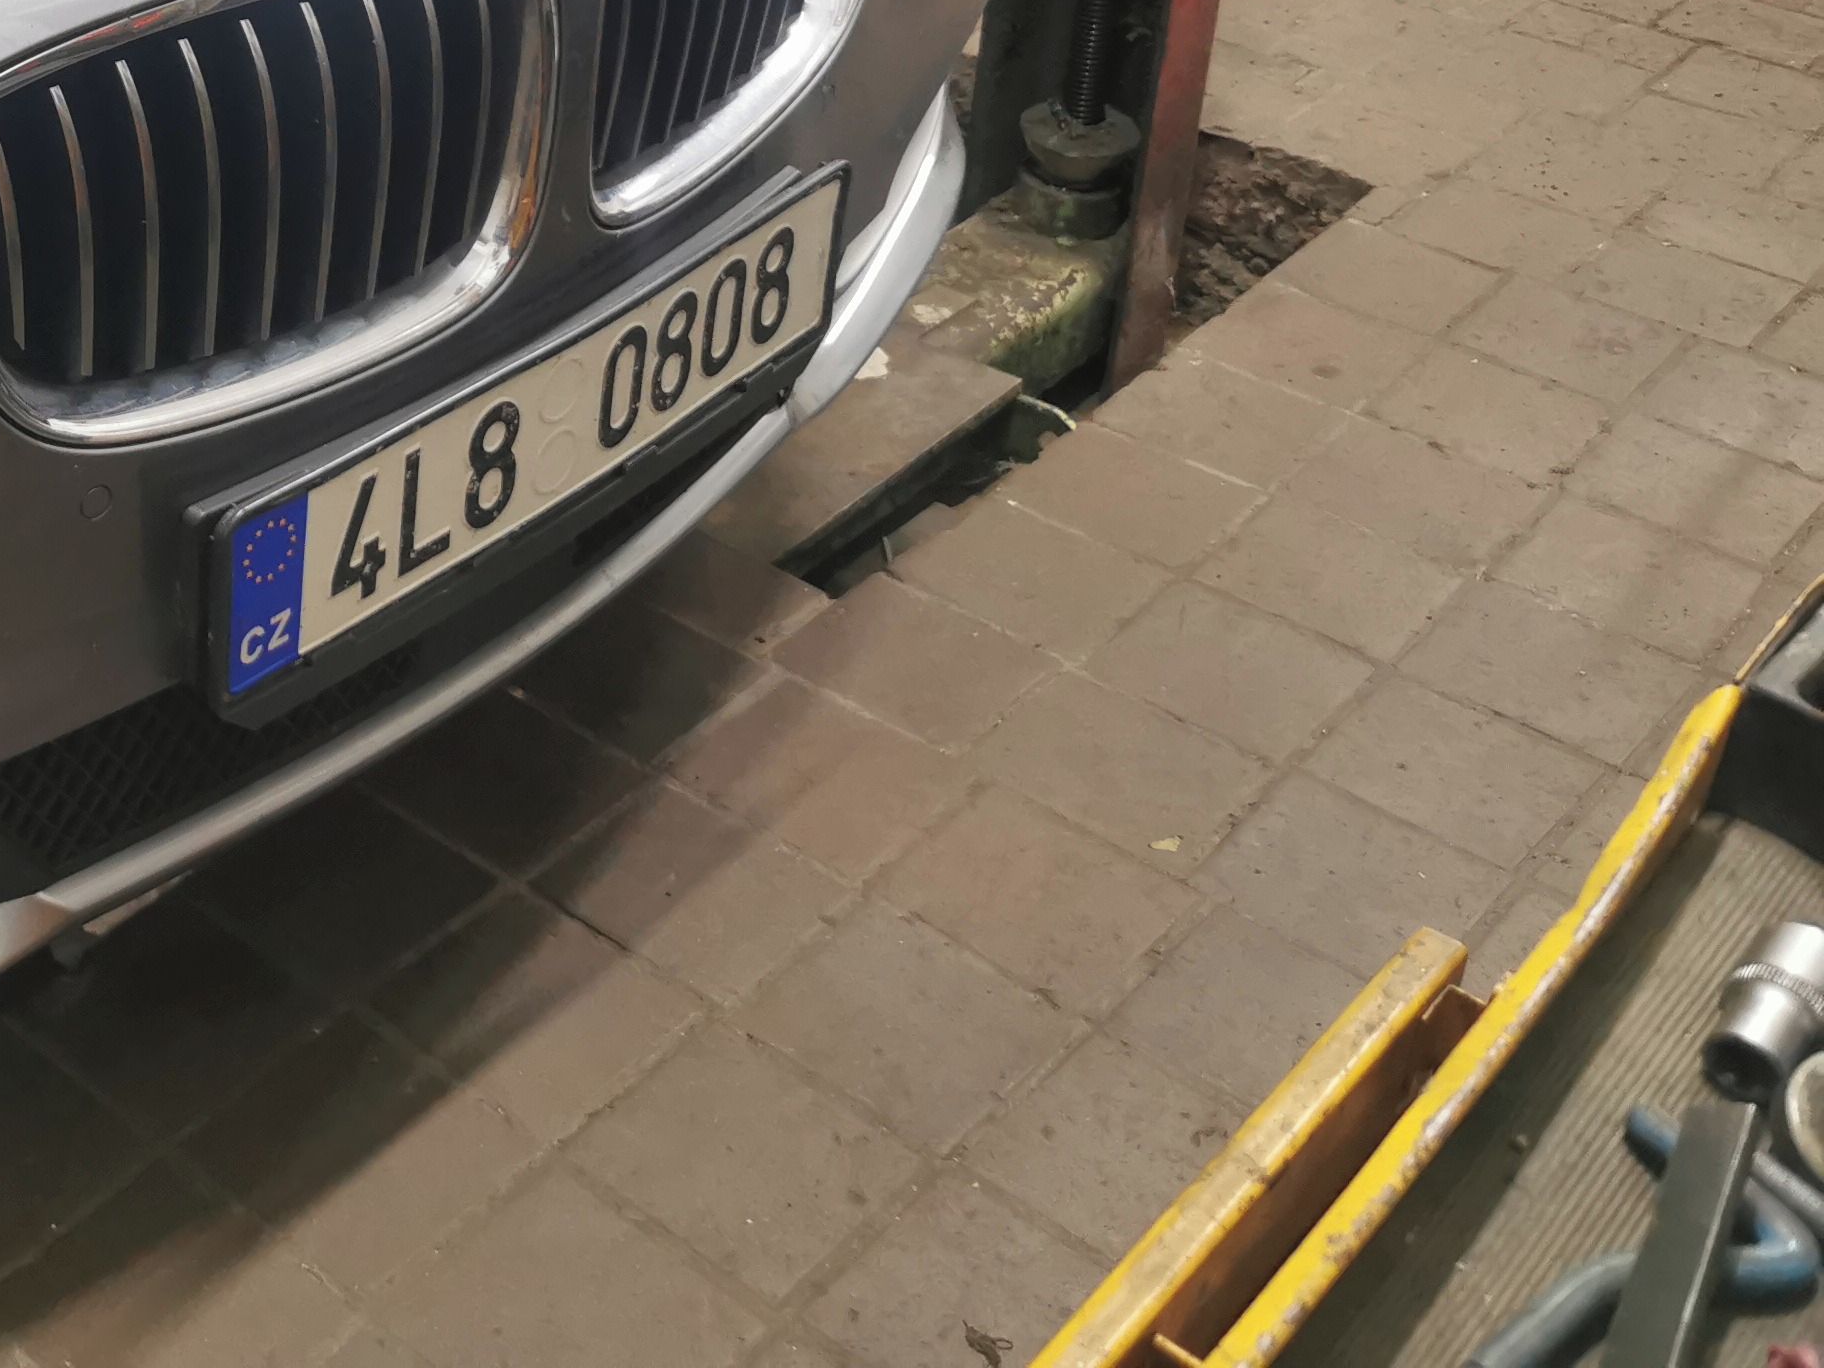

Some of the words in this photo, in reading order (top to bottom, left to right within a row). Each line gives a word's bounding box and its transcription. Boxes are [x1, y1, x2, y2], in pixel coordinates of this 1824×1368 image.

[330, 401, 521, 600] 4L8
[597, 226, 795, 448] 0808
[239, 608, 292, 666] CZ
